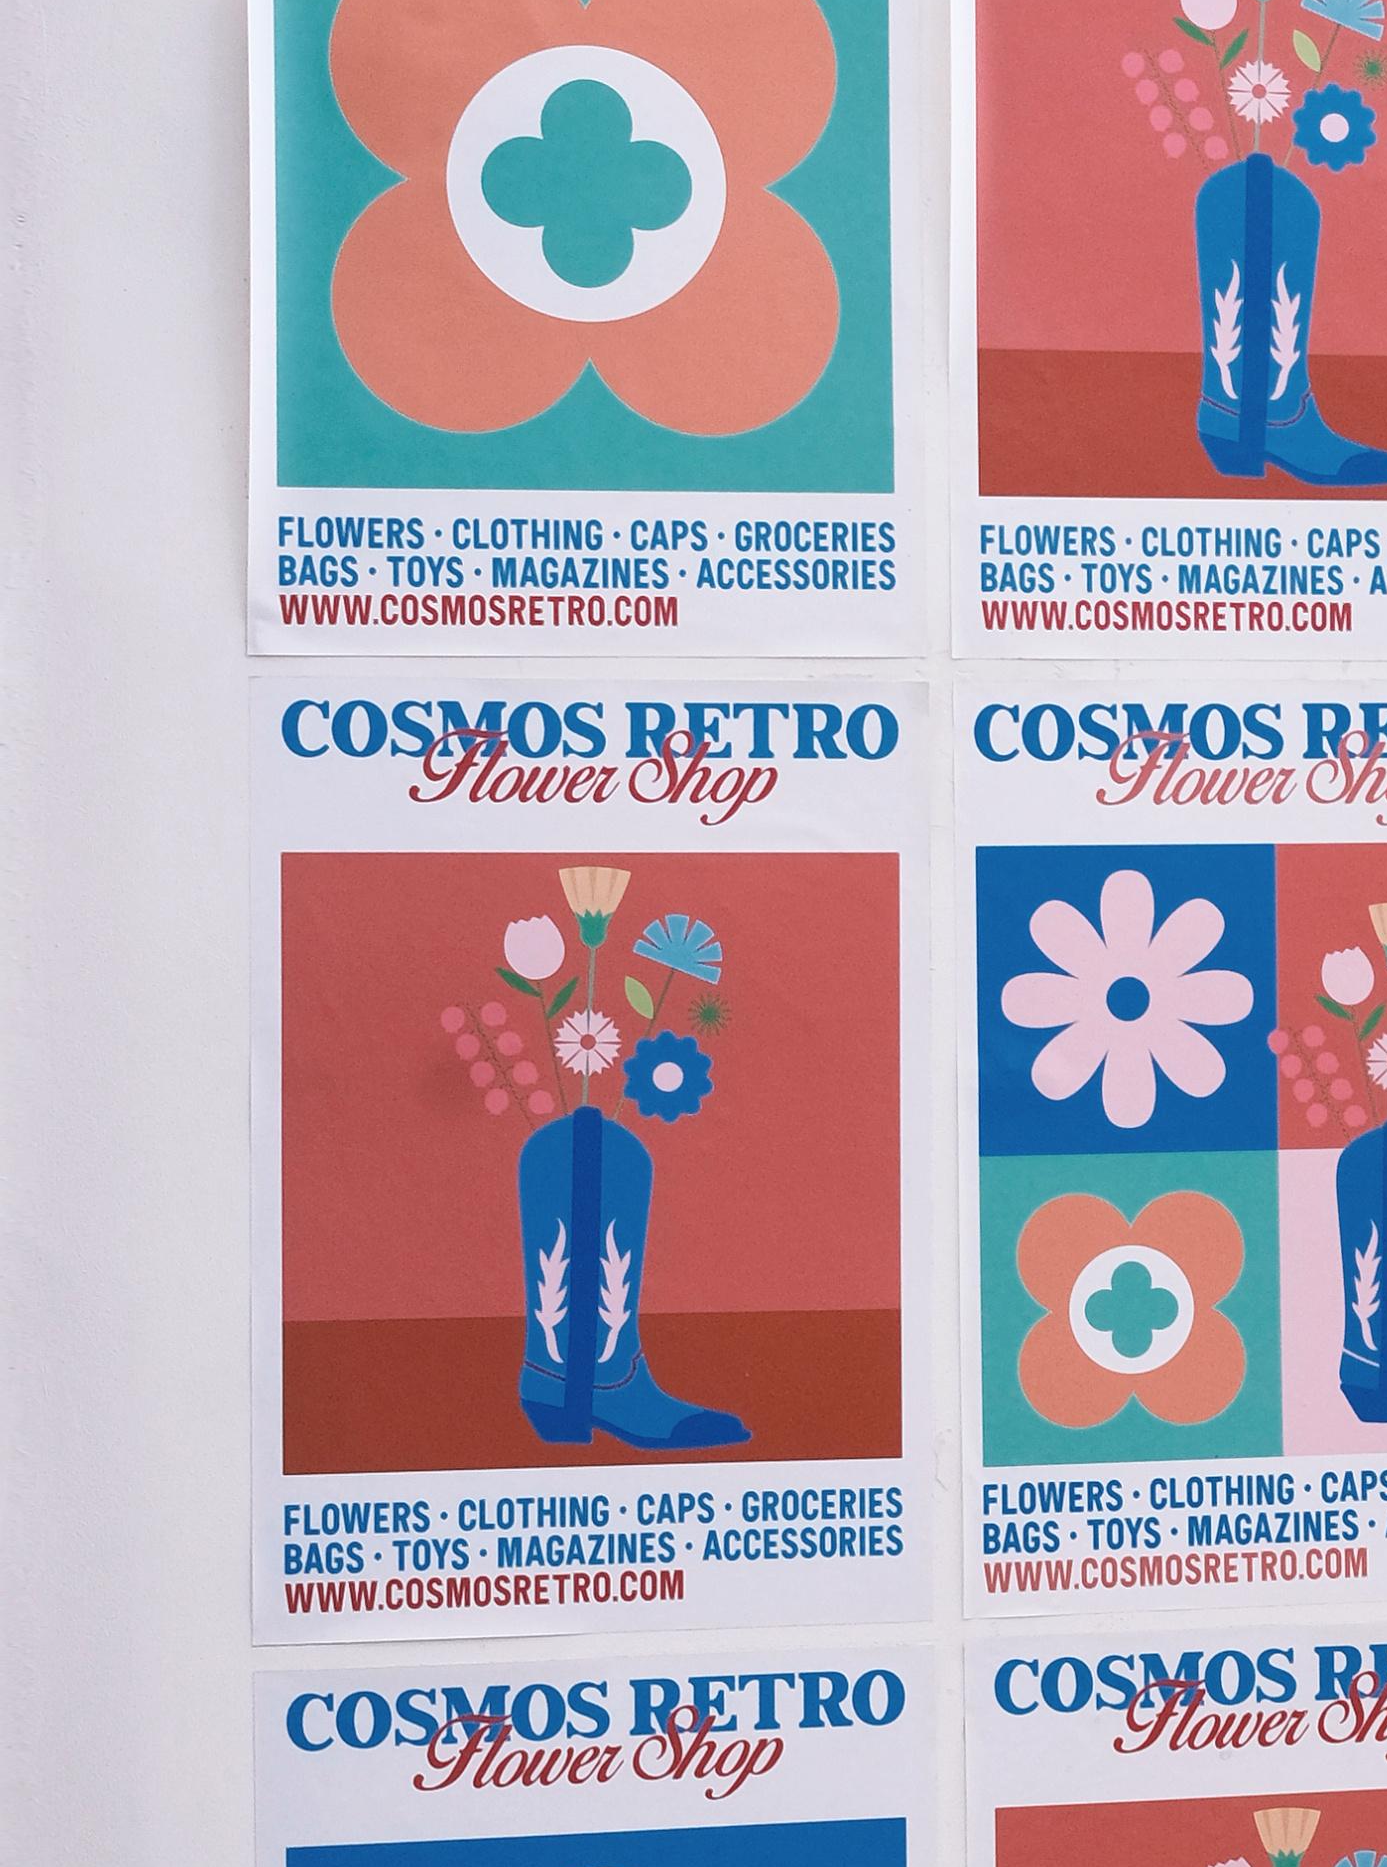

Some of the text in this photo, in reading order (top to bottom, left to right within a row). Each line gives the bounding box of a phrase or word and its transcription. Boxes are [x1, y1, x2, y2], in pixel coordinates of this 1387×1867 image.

[278, 516, 896, 553] FLOWERS CLOTHING CAPS GROCERIES
[980, 524, 1116, 557] FLOWERS
[1142, 526, 1281, 558] CLOTHING
[1307, 528, 1381, 558] CAPS
[278, 553, 896, 590] BAGS TOYS MAGAZINES ACCESSORIES
[980, 561, 1055, 593] BAGS
[1081, 562, 1152, 594] TOYS
[1178, 564, 1344, 595] MAGAZINES
[280, 594, 678, 626] WWW.COSMOSRETRO.COM
[982, 600, 1352, 631] WWW.COSMOSRETRO.COM
[280, 699, 899, 760] COSMOS RETRO
[973, 702, 1284, 762] COSMOS
[409, 728, 778, 825] Flower Shop
[1096, 730, 1296, 805] Flower
[283, 1487, 903, 1537] FLOWERS CLOTHING CAPS GROCERIES
[983, 1479, 1123, 1516] FLOWERS
[1149, 1473, 1295, 1510] CLOTHING
[283, 1524, 903, 1576] BAGS TOYS MAGAZINES ACCESSORIES
[983, 1520, 1060, 1555] BAGS
[1087, 1516, 1161, 1550] TOYS
[1188, 1508, 1358, 1546] MAGAZINES
[286, 1569, 684, 1613] WWW.COSMOSRETRO.COM
[984, 1547, 1367, 1593] WWW.COSMOSRETRO.COM
[994, 1647, 1296, 1715] COSMOS
[285, 1669, 905, 1752] COSMOS RETRO
[1113, 1679, 1307, 1754] Flower
[412, 1704, 784, 1799] Flower Shop
